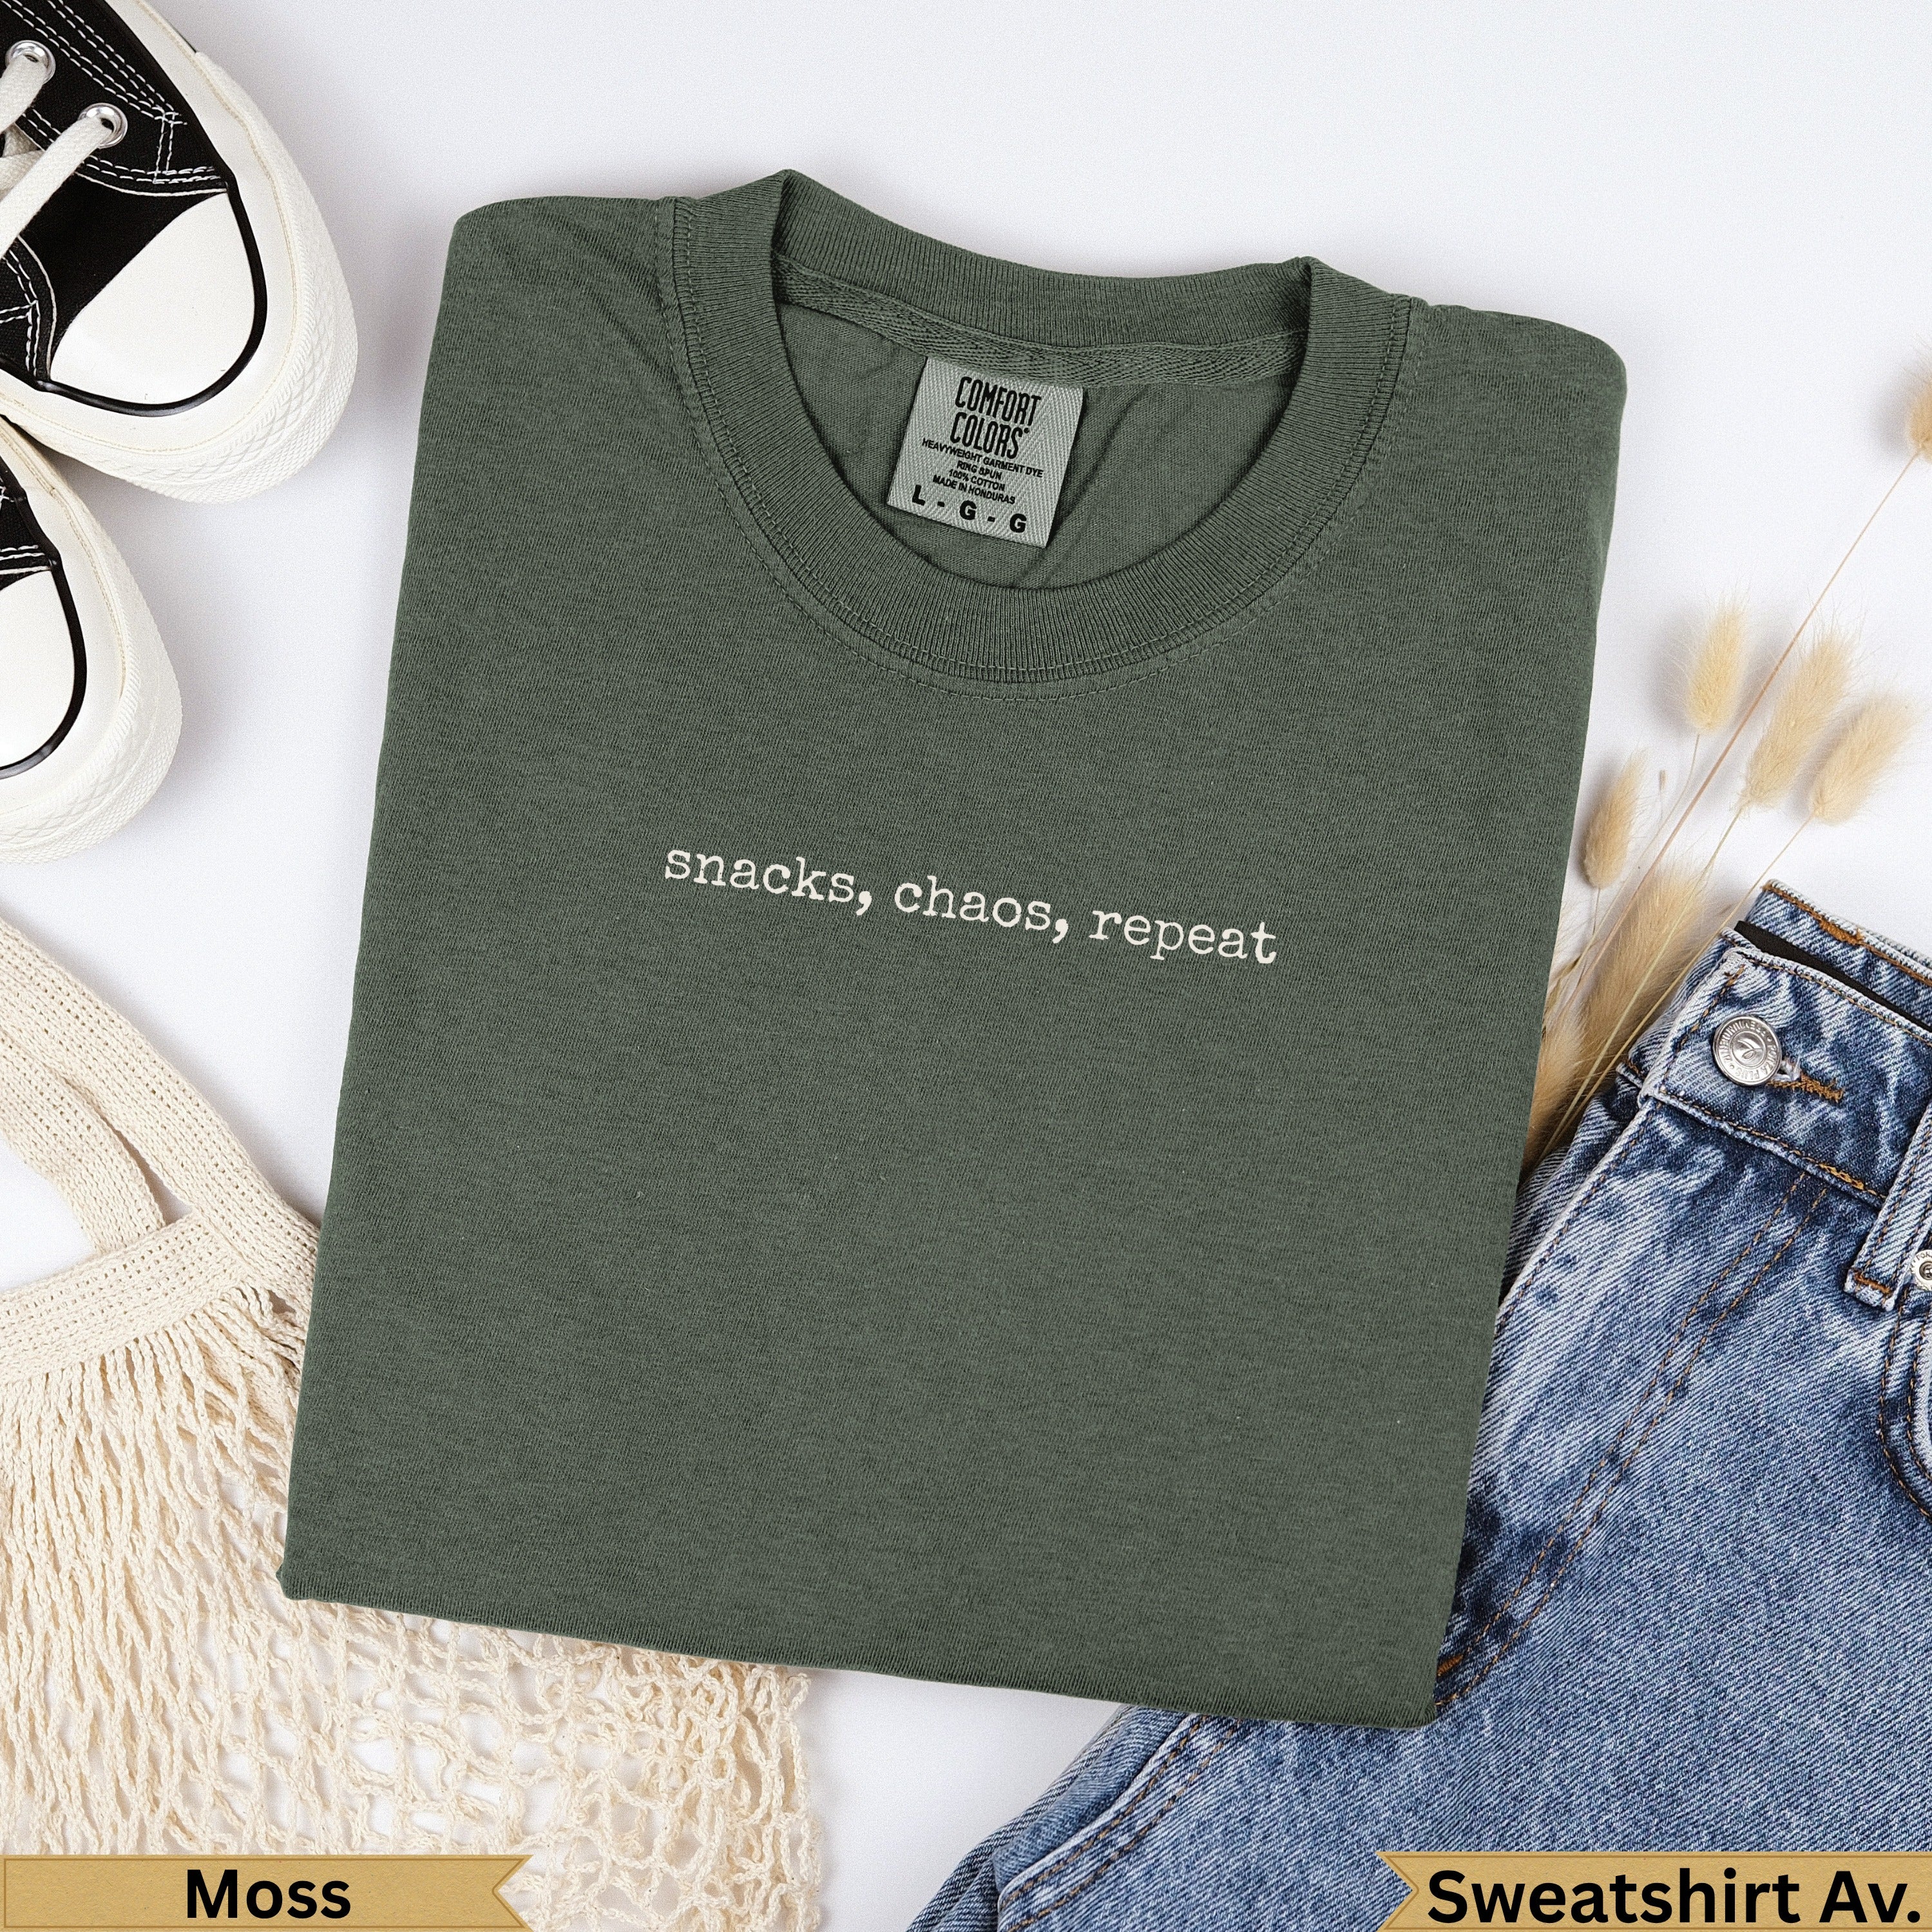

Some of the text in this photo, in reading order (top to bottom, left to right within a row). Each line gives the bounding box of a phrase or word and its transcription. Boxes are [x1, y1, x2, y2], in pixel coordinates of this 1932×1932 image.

[955, 376, 1042, 426] COMFORT
[922, 437, 1044, 478] HEAVYWEIGHT GARMENT DYE
[957, 460, 1002, 480] RING SPUN
[933, 474, 1016, 505] MADE IN HONDURAS
[949, 469, 1006, 492] 100% COTTON
[912, 484, 926, 506] L
[959, 500, 977, 521] G
[1009, 513, 1028, 533] G
[664, 849, 1277, 965] snacks, chaos, repeat
